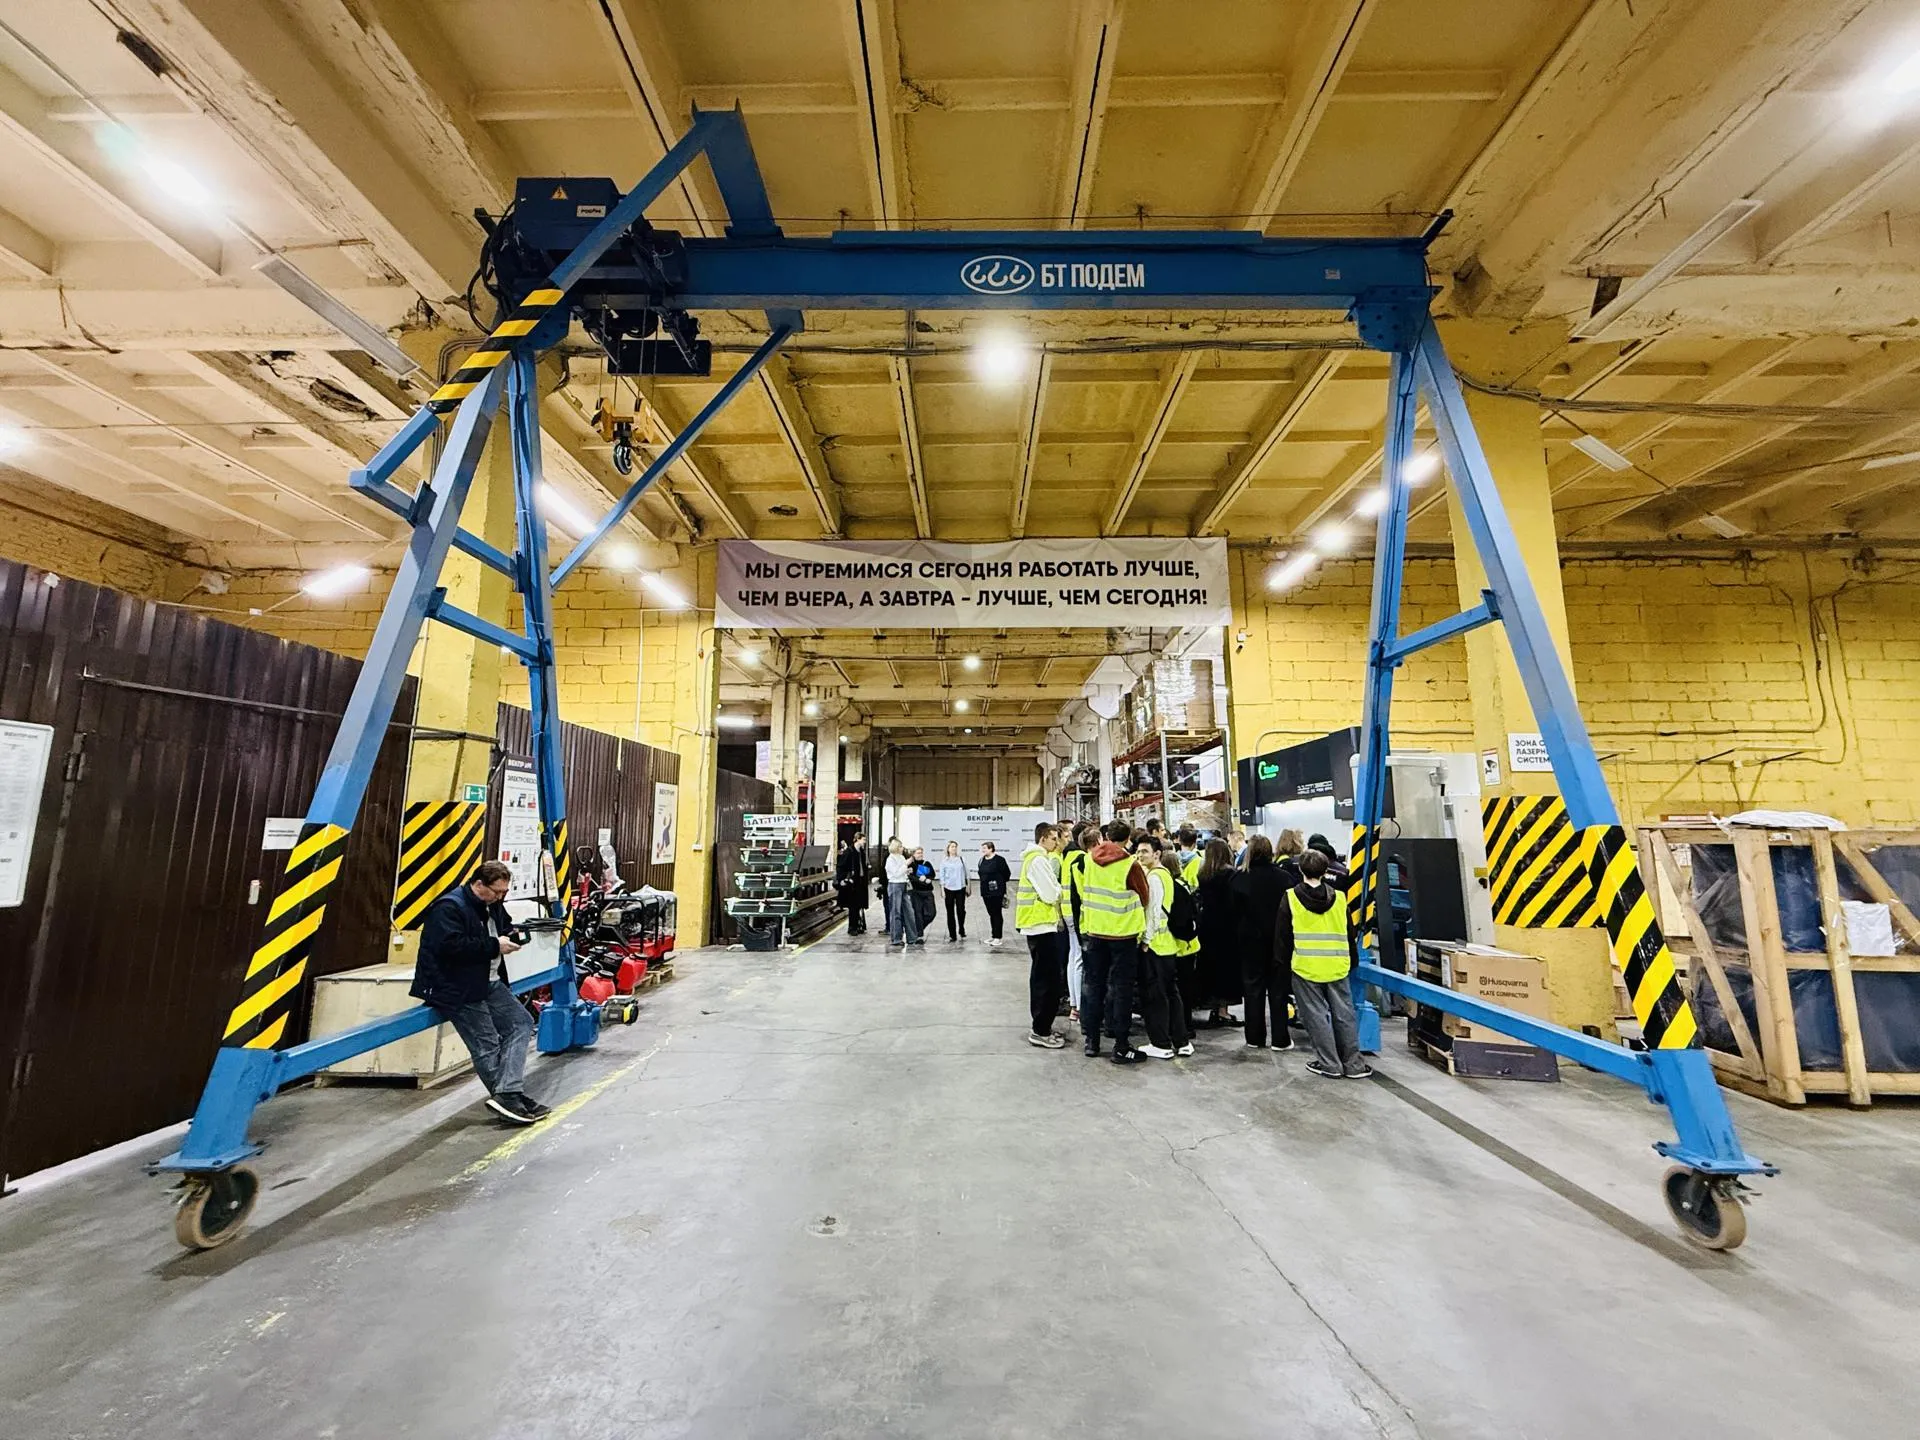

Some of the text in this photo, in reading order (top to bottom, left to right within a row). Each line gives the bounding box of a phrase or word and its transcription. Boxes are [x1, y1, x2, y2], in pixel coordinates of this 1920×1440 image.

[1041, 263, 1145, 291] БТ ПОДЕМ
[745, 560, 1200, 580] МЫ СТРЕМИМСЯ СЕГОДНЯ РАБОТАТЬ ЛУЧШЕ,
[738, 590, 779, 607] ЧЕМ
[784, 590, 854, 609] ВЧЕРА,
[859, 590, 875, 607] А
[879, 590, 956, 607] ЗАВТРА
[976, 589, 1053, 608] ЛУЧШЕ,
[1058, 589, 1101, 606] ЧЕМ
[1106, 588, 1208, 607] СЕГОДНЯ!
[1487, 977, 1528, 988] Husqvarna
